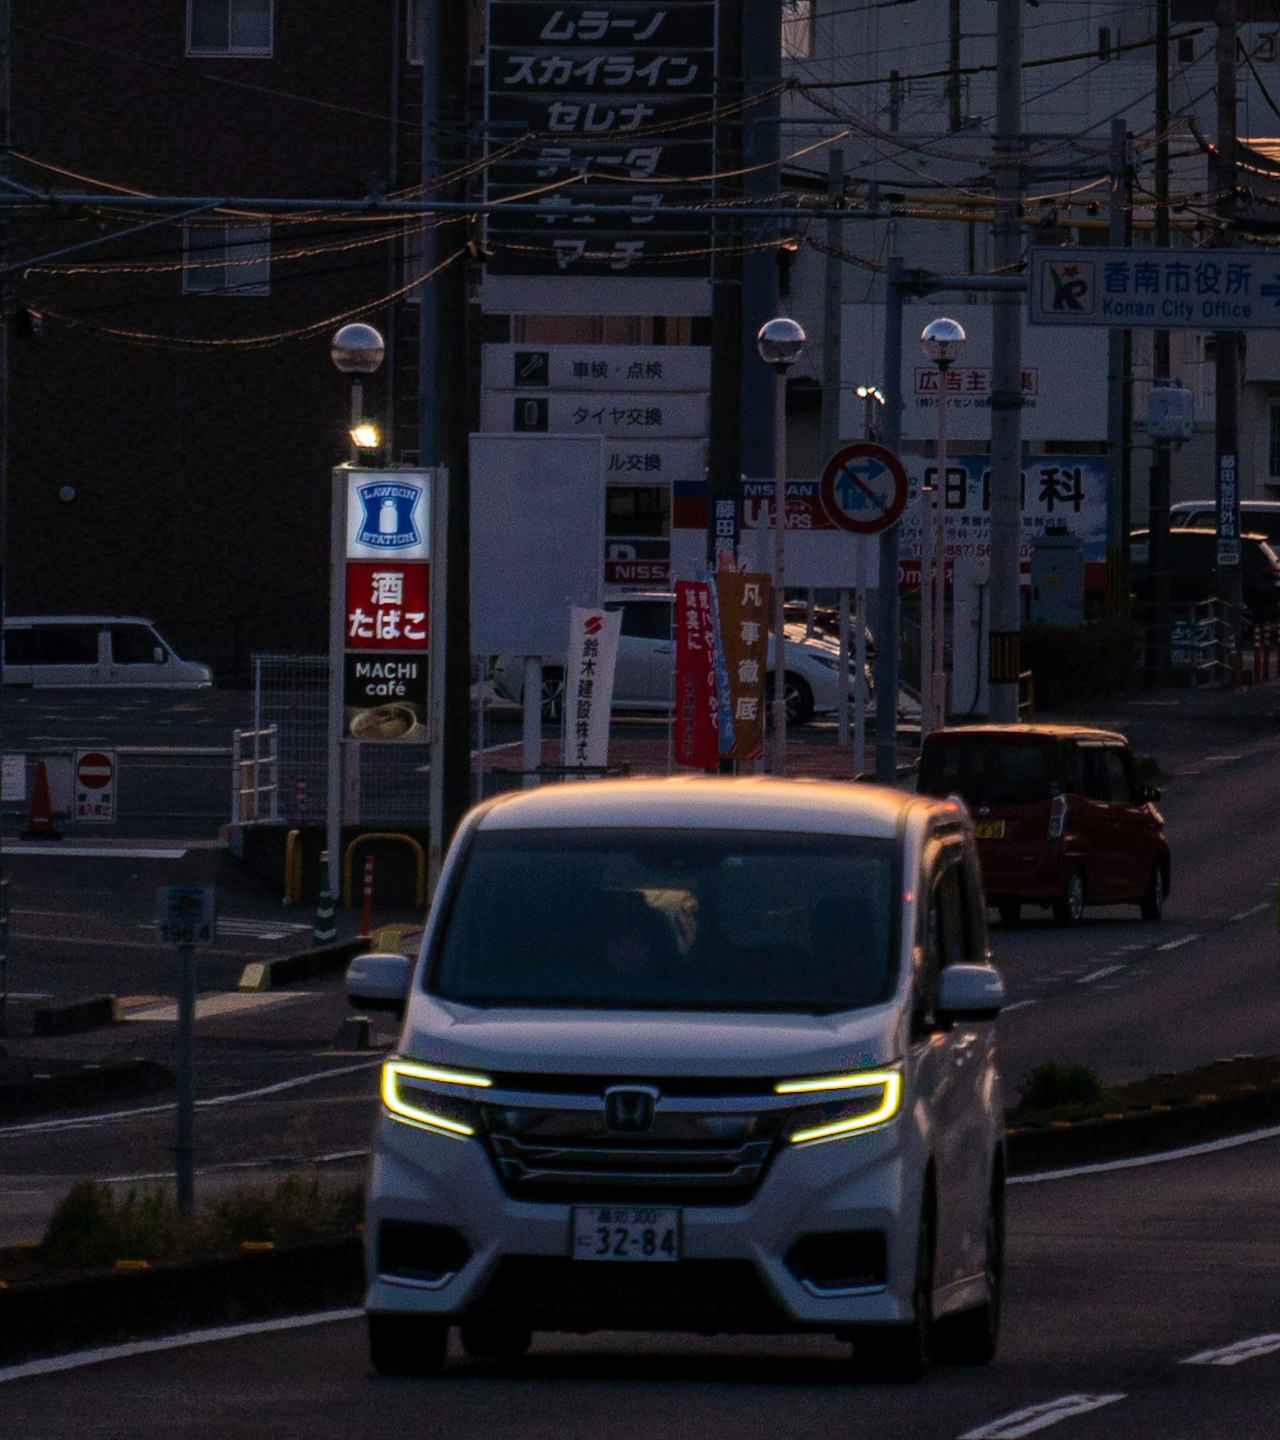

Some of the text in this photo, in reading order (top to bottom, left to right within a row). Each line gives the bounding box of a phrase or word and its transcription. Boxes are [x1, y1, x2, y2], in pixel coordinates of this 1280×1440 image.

[540, 10, 666, 40] ムラーノ
[504, 55, 698, 86] スカイライン
[548, 102, 655, 132] セレナ
[1103, 262, 1252, 295] 香南市役所
[1103, 300, 1251, 320] Konan City Office
[573, 361, 663, 379] 車検・点検
[574, 408, 663, 426] タイヤ交換
[363, 486, 415, 501] LAWSON
[744, 484, 812, 496] NISAN
[362, 531, 415, 545] STATION
[371, 571, 405, 605] 酒
[349, 607, 427, 640] たばこ
[356, 662, 418, 680] MACHI
[365, 681, 406, 696] café
[595, 1227, 674, 1256] 32-84
